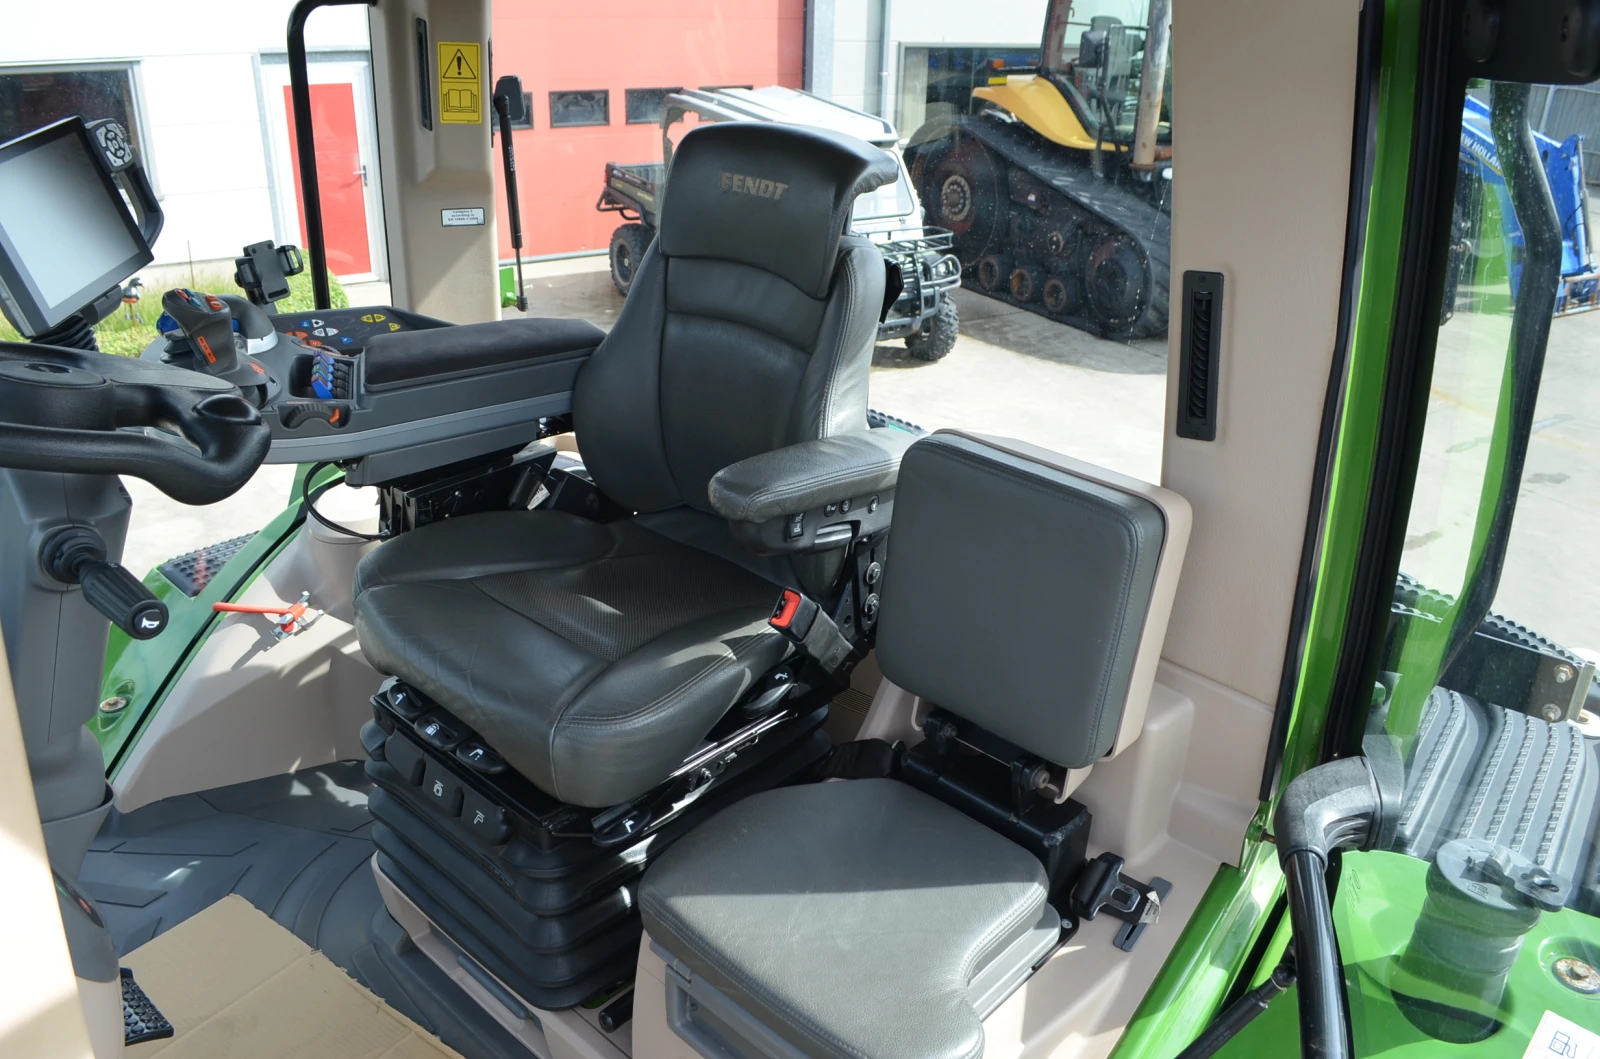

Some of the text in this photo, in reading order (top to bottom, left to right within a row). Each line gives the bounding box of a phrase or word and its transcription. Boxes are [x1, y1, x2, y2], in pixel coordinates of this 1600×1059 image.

[1460, 133, 1501, 171] EW HOLLAN
[720, 171, 789, 200] FENDT
